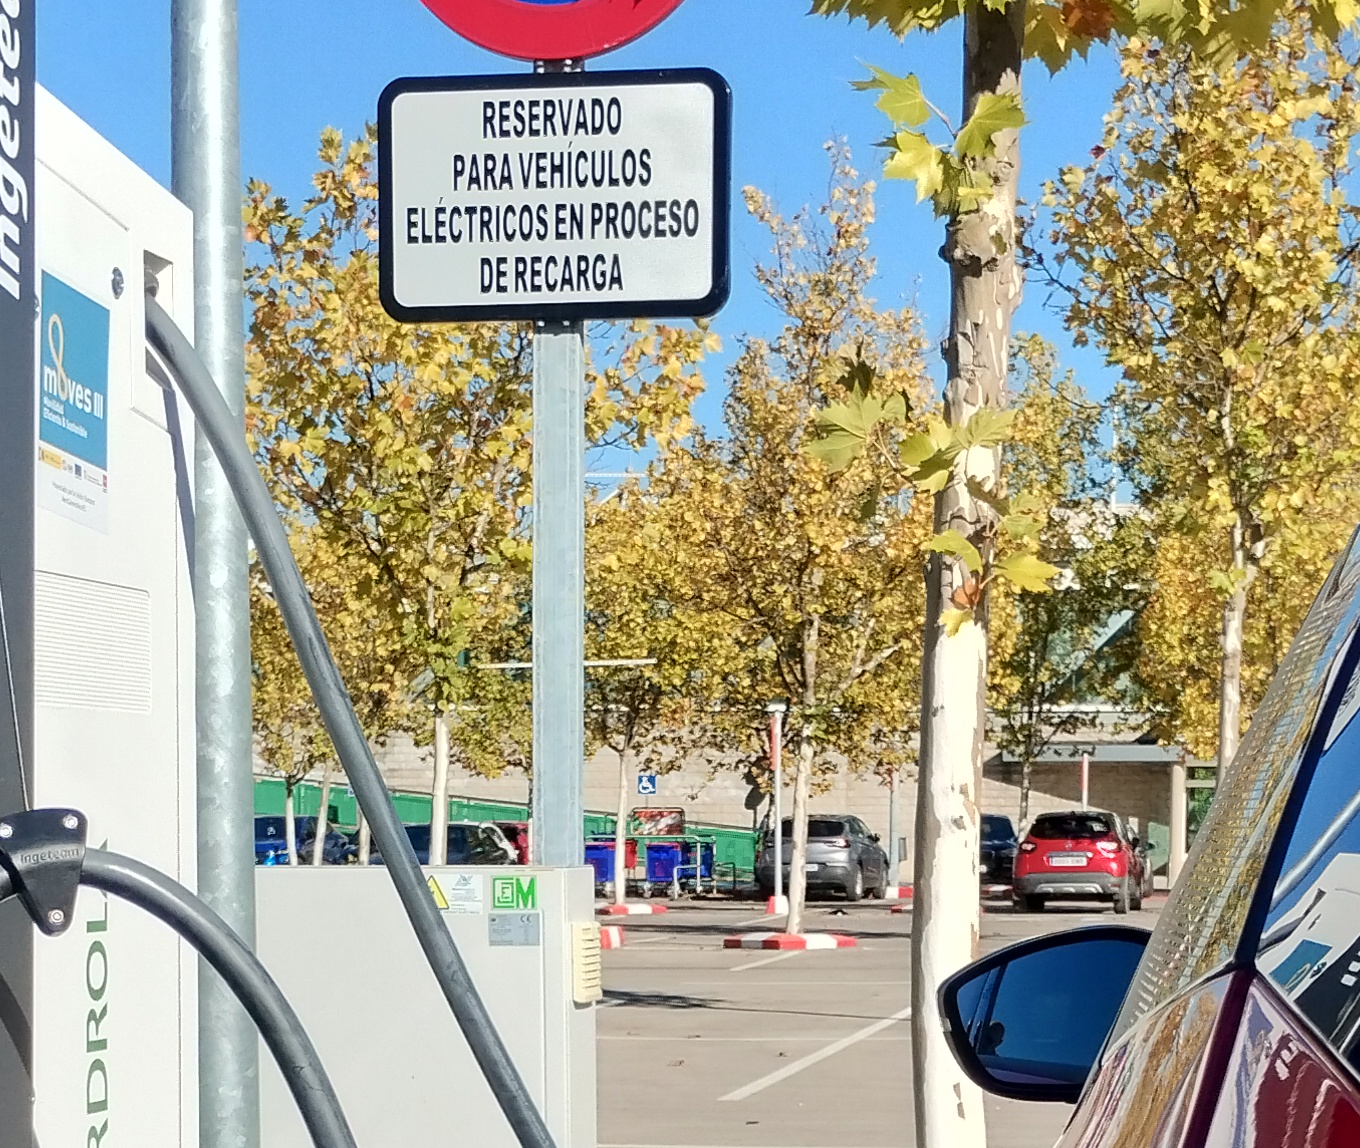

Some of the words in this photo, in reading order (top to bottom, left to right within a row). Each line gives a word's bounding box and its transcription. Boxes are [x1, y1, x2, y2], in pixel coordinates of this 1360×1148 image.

[482, 97, 622, 139] RESERVADO
[452, 152, 513, 192] PARA
[519, 141, 652, 190] VEHÍCULOS
[406, 196, 548, 244] ELÉCTRICOS
[555, 203, 584, 241] EN
[591, 198, 699, 239] PROCESO
[480, 256, 508, 294] DE
[515, 253, 624, 293] RECARGA
